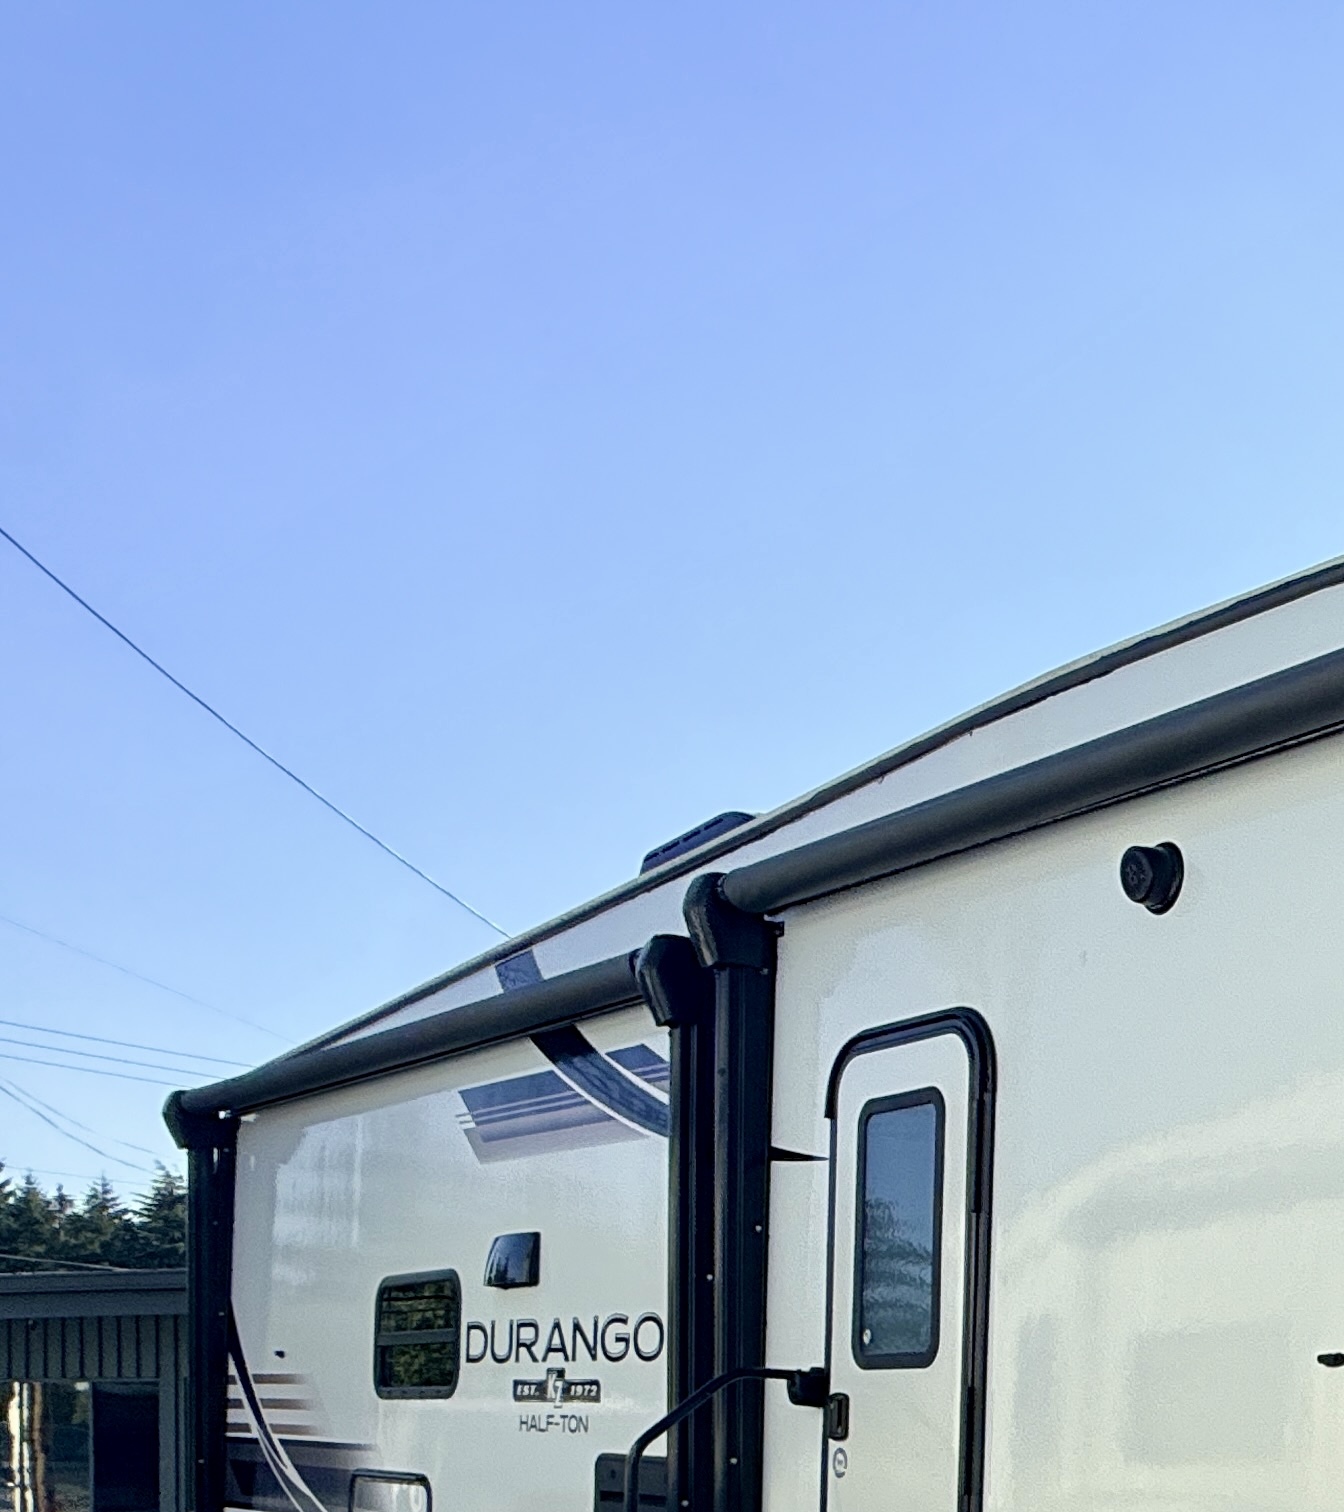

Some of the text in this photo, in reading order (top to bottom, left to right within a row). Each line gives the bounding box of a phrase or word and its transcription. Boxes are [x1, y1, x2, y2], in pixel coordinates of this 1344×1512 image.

[466, 1312, 664, 1363] DURANGO
[516, 1384, 539, 1396] EST.
[570, 1384, 597, 1396] 1972
[519, 1414, 588, 1433] HALF-TON
